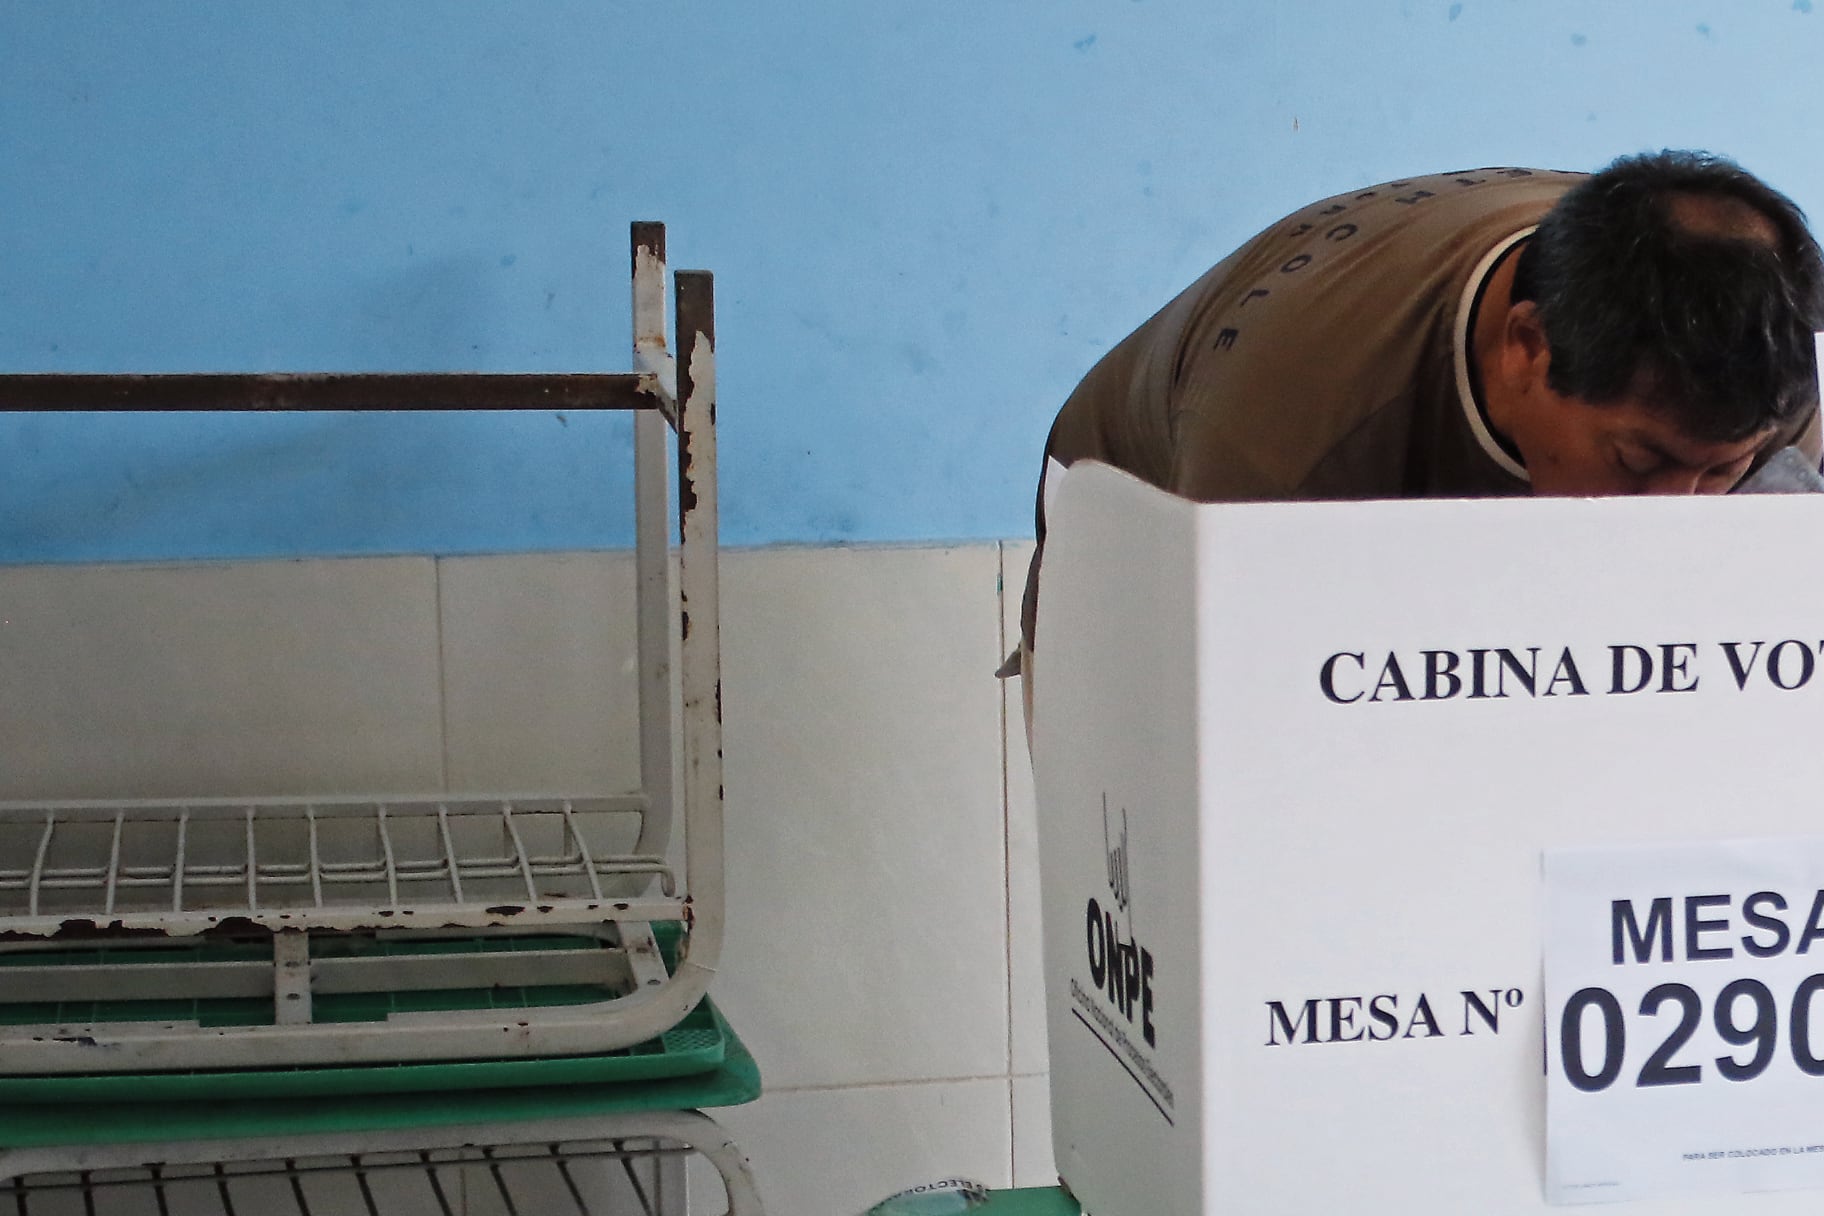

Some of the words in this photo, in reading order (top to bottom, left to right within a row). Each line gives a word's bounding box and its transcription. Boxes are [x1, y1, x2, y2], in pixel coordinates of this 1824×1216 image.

[1318, 645, 1591, 706] CABINA
[1605, 642, 1701, 696] DE
[1086, 896, 1156, 1050] ONPE
[1263, 991, 1446, 1047] MESA
[1458, 986, 1525, 1037] Nº
